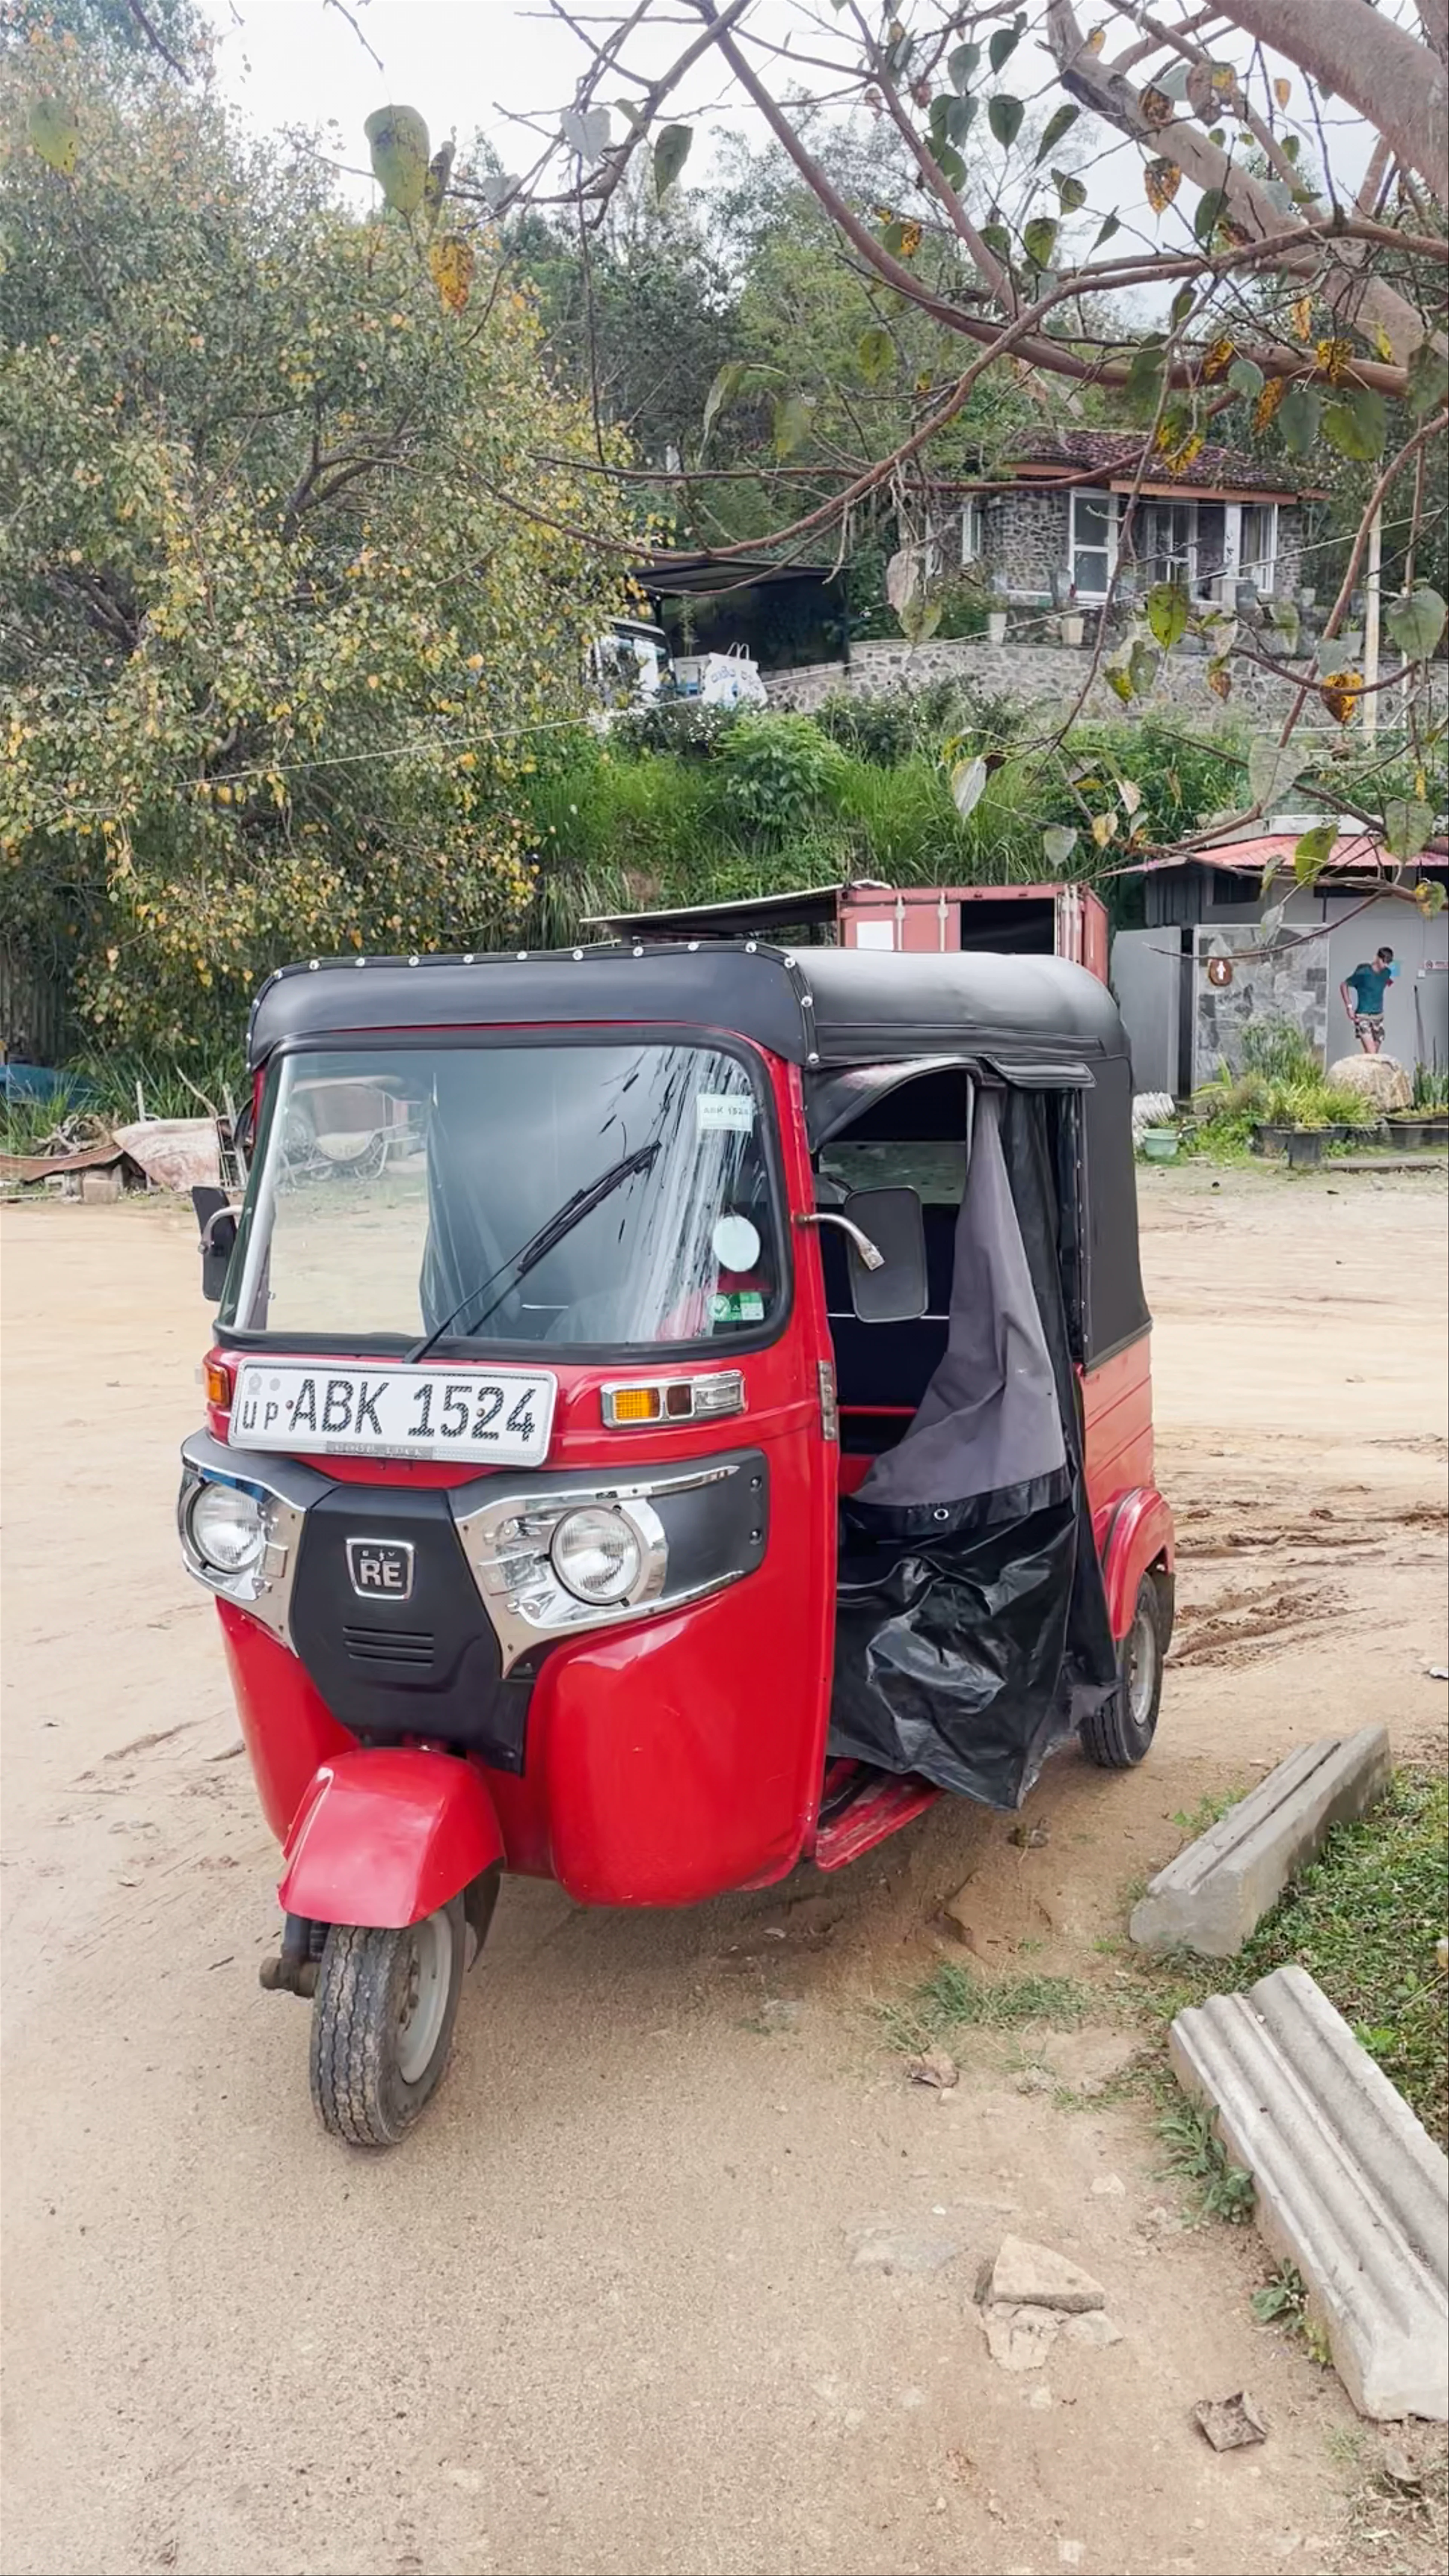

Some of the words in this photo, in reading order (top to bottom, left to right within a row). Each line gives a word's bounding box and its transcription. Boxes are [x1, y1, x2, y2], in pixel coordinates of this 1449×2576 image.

[243, 1401, 279, 1430] UP
[288, 1379, 389, 1434] ABK
[407, 1383, 536, 1442] 1524
[360, 1559, 402, 1587] RE
